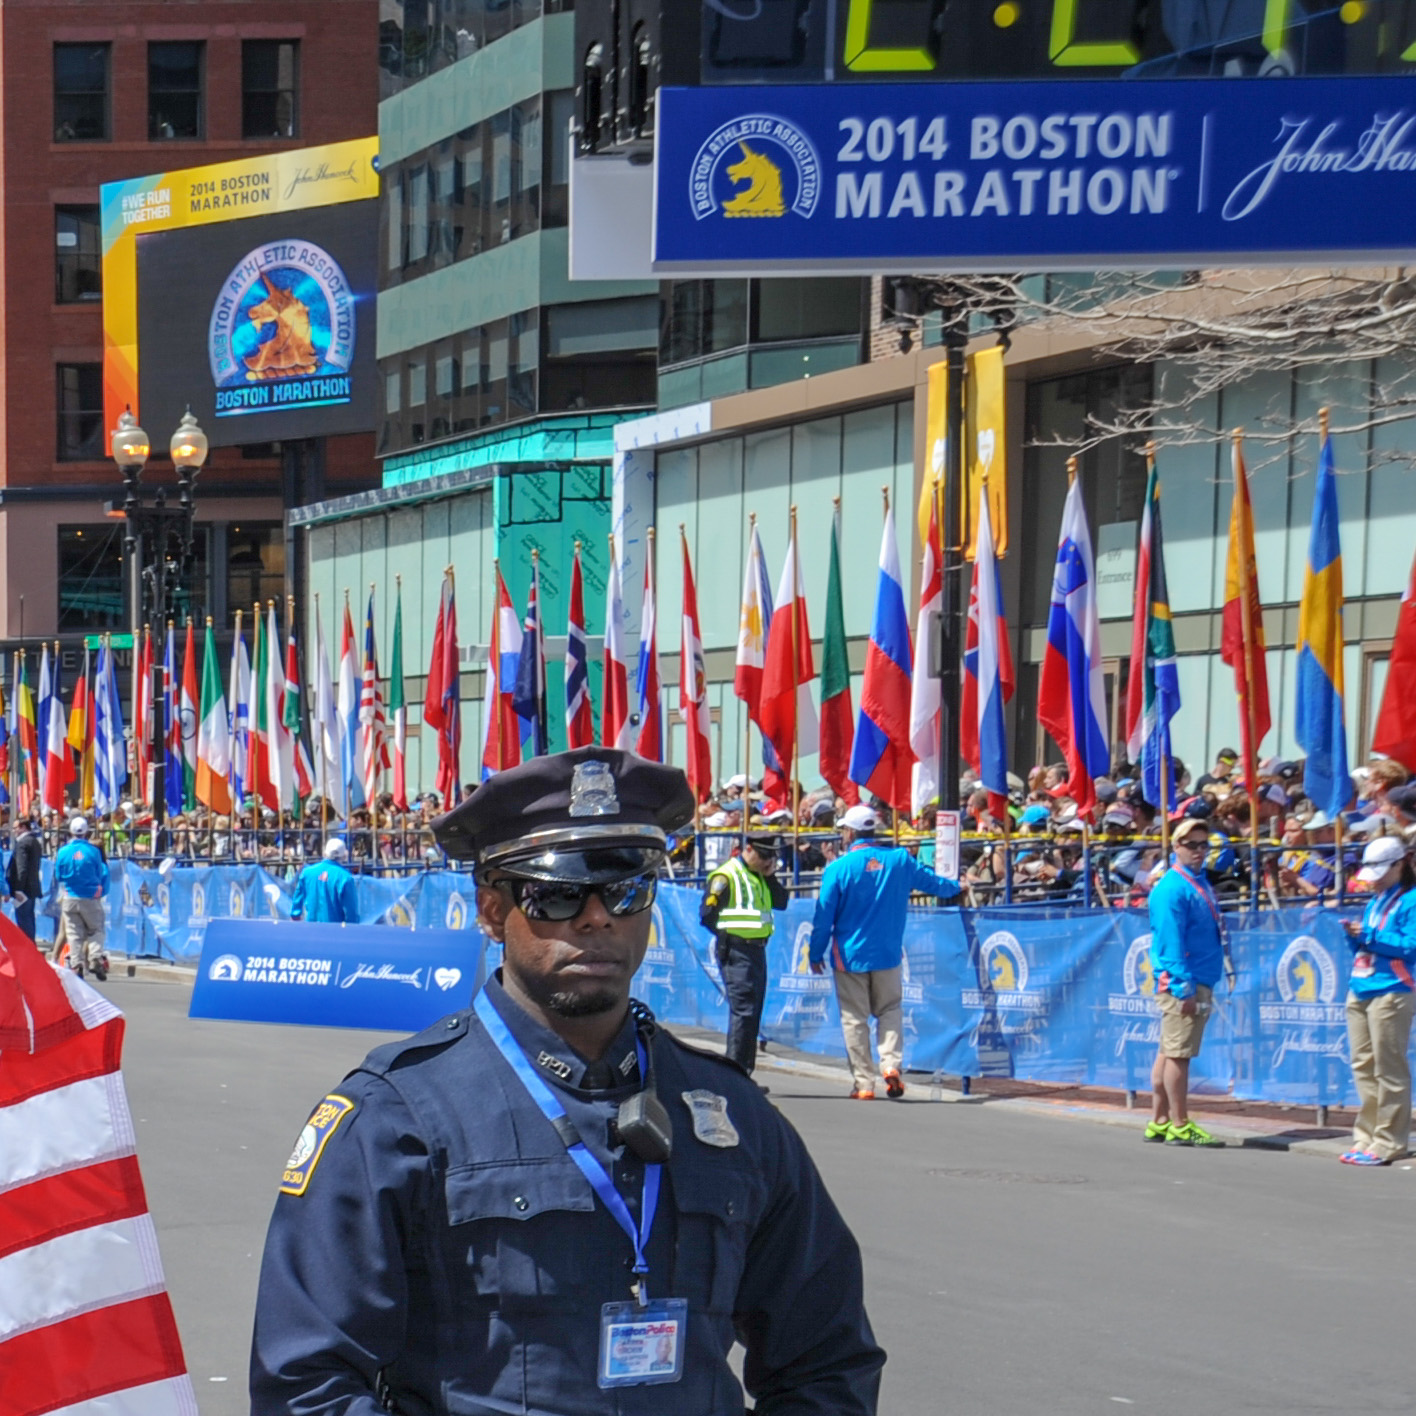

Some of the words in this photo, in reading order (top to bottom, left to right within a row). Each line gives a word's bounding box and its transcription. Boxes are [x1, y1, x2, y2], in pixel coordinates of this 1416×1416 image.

[836, 116, 949, 162] 2014
[969, 113, 1170, 160] BOSTON
[694, 154, 714, 211] BOSTON
[708, 119, 772, 157] ATHLETIC
[772, 124, 817, 210] ASSOCIATION
[1221, 115, 1338, 222] John
[190, 182, 215, 197] 2014
[221, 171, 270, 191] BOSTON
[284, 167, 316, 200] John
[312, 159, 360, 184] Hancock
[121, 190, 146, 211] #WE
[146, 187, 170, 204] RUN
[190, 188, 271, 214] MARATHON
[834, 167, 1168, 219] MARATHON
[121, 204, 171, 225] TOGETHER
[214, 296, 235, 373] BOSTON
[230, 245, 297, 295] ATHLETIC
[298, 247, 352, 358] ASSOCIATION
[215, 385, 269, 410] BOSTON
[273, 377, 350, 403] MARATHON
[246, 956, 276, 970] 2014
[278, 957, 332, 972] BOSTON
[243, 969, 332, 986] MARATHON
[1108, 997, 1145, 1012] BOSTON
[1259, 1006, 1299, 1020] BOSTON
[1300, 1006, 1346, 1021] MARATH
[536, 1050, 572, 1079] BPD
[282, 1170, 304, 1184] 630
